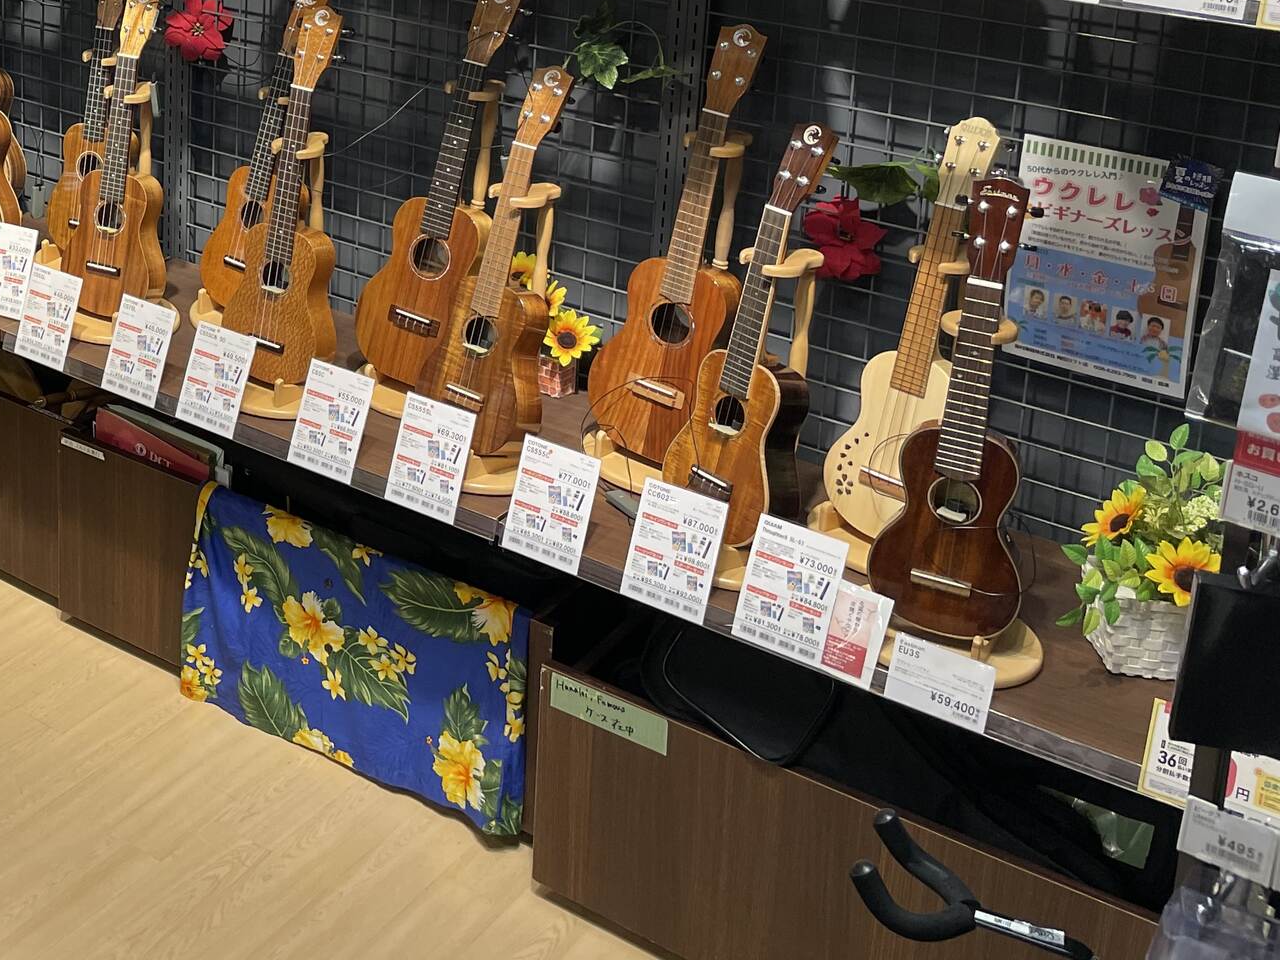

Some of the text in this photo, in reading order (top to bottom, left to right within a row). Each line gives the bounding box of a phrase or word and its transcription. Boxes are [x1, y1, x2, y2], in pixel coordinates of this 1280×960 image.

[1033, 178, 1134, 214] ウクレレ
[898, 644, 921, 659] EU3S
[930, 691, 975, 716] ¥59,400
[1157, 750, 1176, 767] 36
